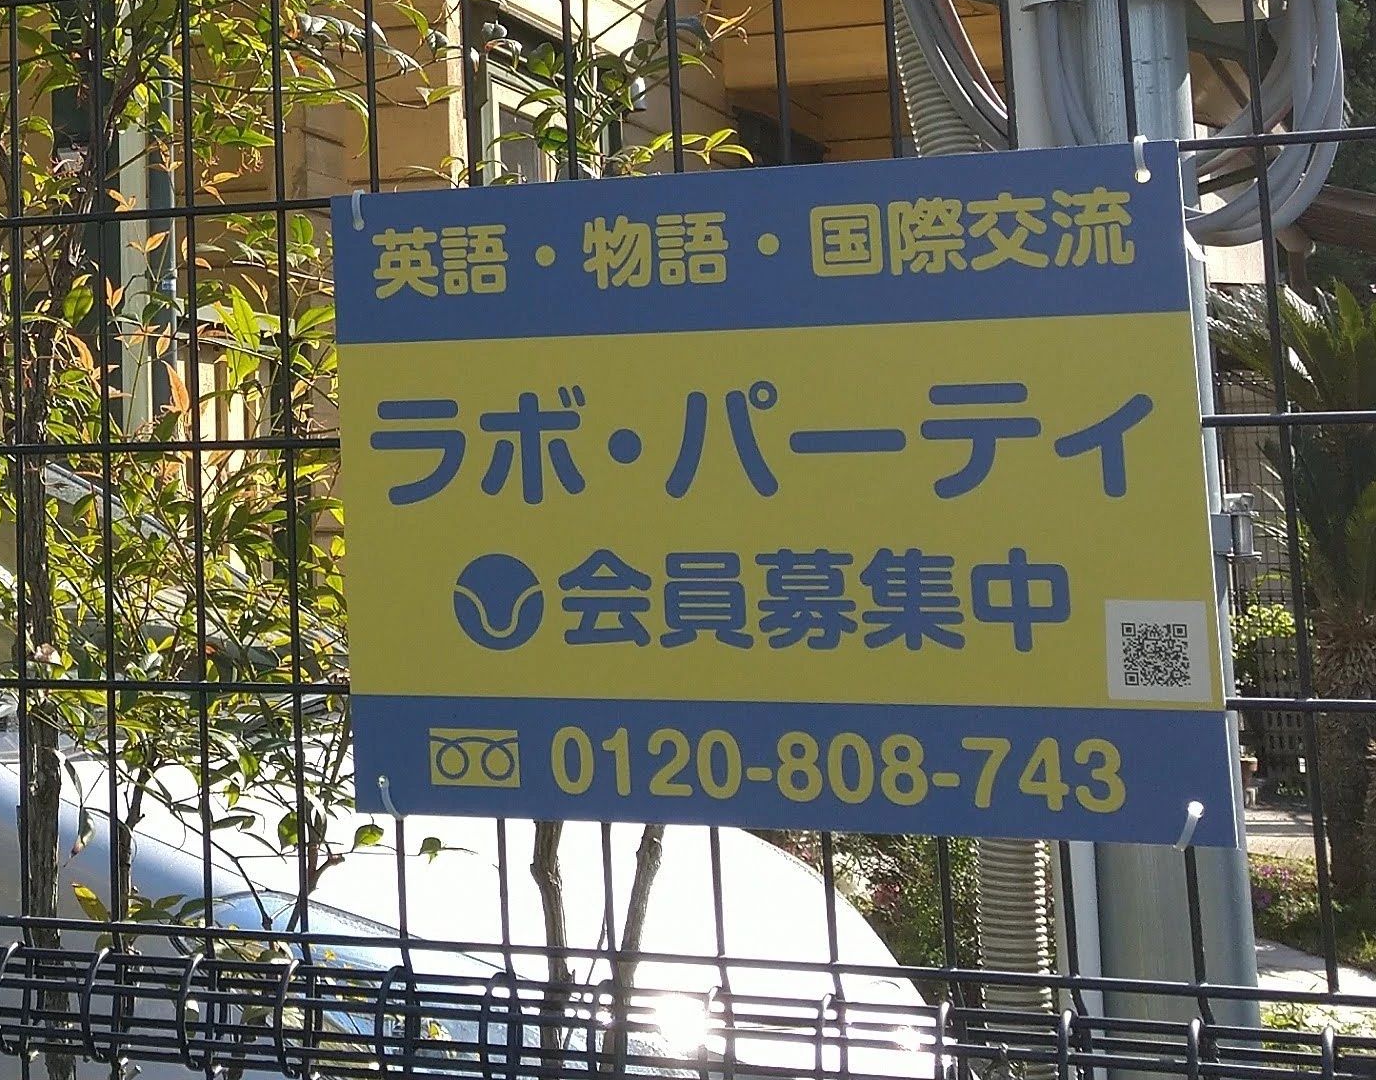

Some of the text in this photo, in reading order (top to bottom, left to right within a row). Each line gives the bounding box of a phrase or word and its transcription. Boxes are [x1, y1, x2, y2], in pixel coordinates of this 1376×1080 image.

[373, 187, 1134, 298] 英語・物語・国際交流
[370, 380, 1154, 505] ラボ・パーティ
[557, 548, 1071, 652] 会員募集中
[551, 727, 1127, 812] 0120-808-743
